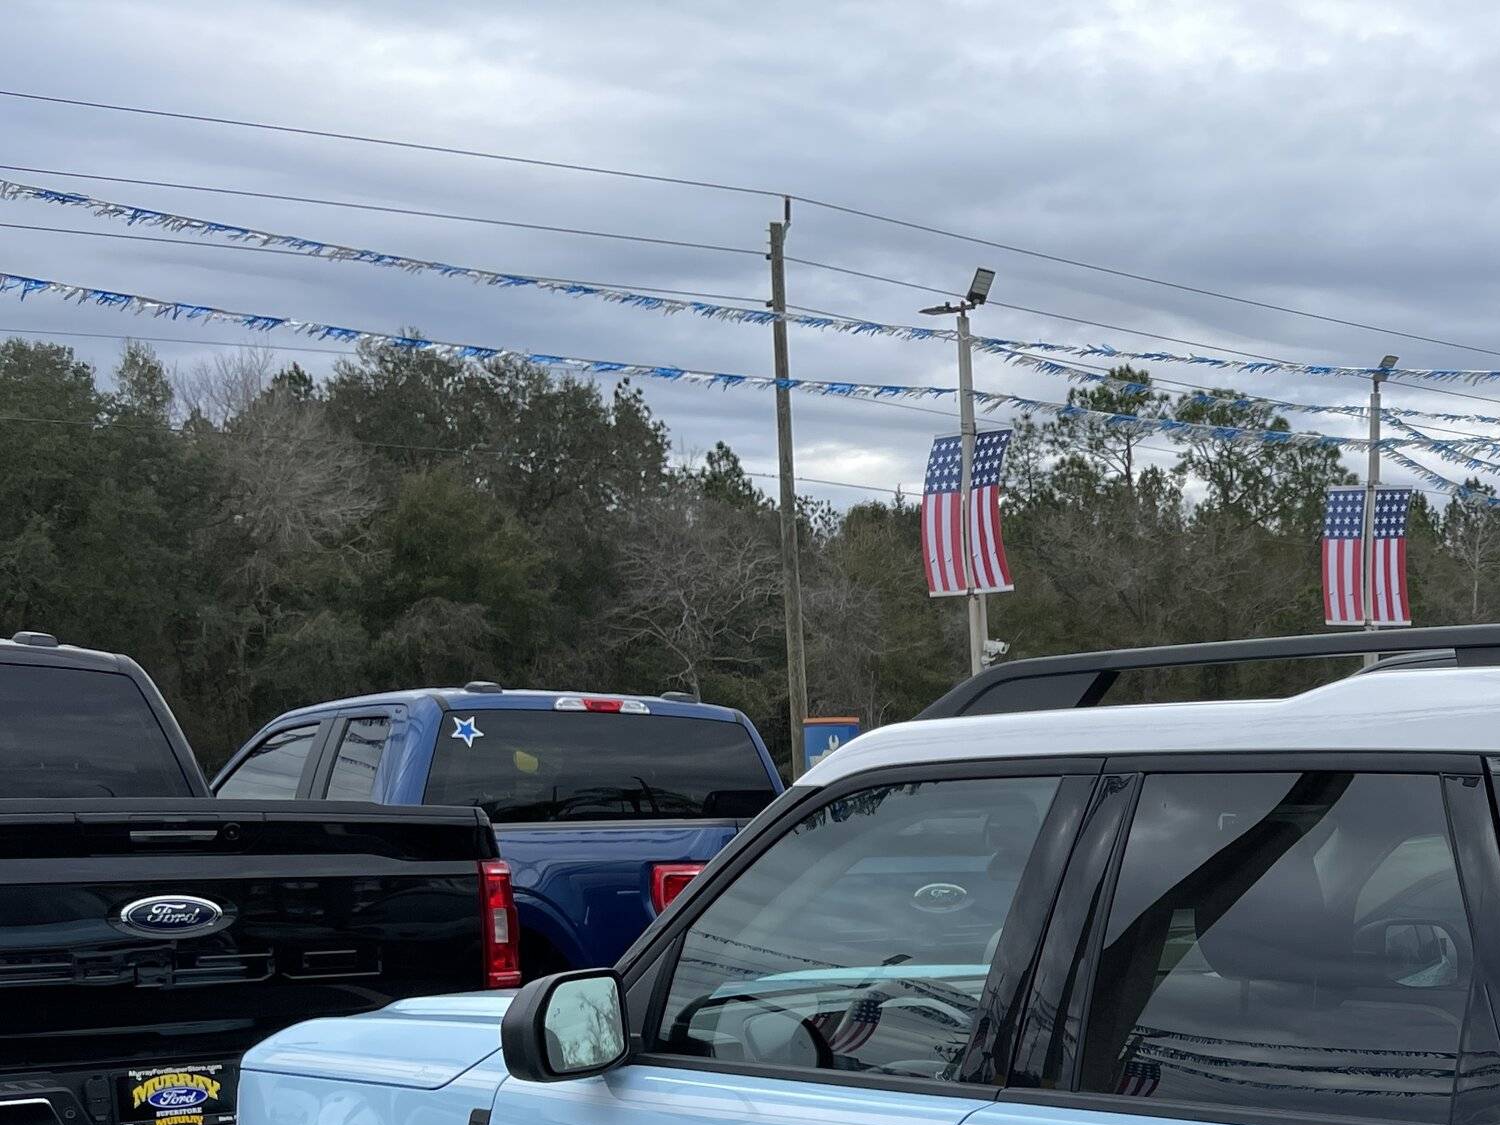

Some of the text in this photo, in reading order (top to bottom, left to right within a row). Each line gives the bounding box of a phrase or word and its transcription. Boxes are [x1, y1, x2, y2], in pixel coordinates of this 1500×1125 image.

[146, 903, 200, 924] Ford
[132, 1073, 221, 1109] MURRAY
[159, 1089, 197, 1105] Ford
[156, 1107, 203, 1117] SUPERSTORE
